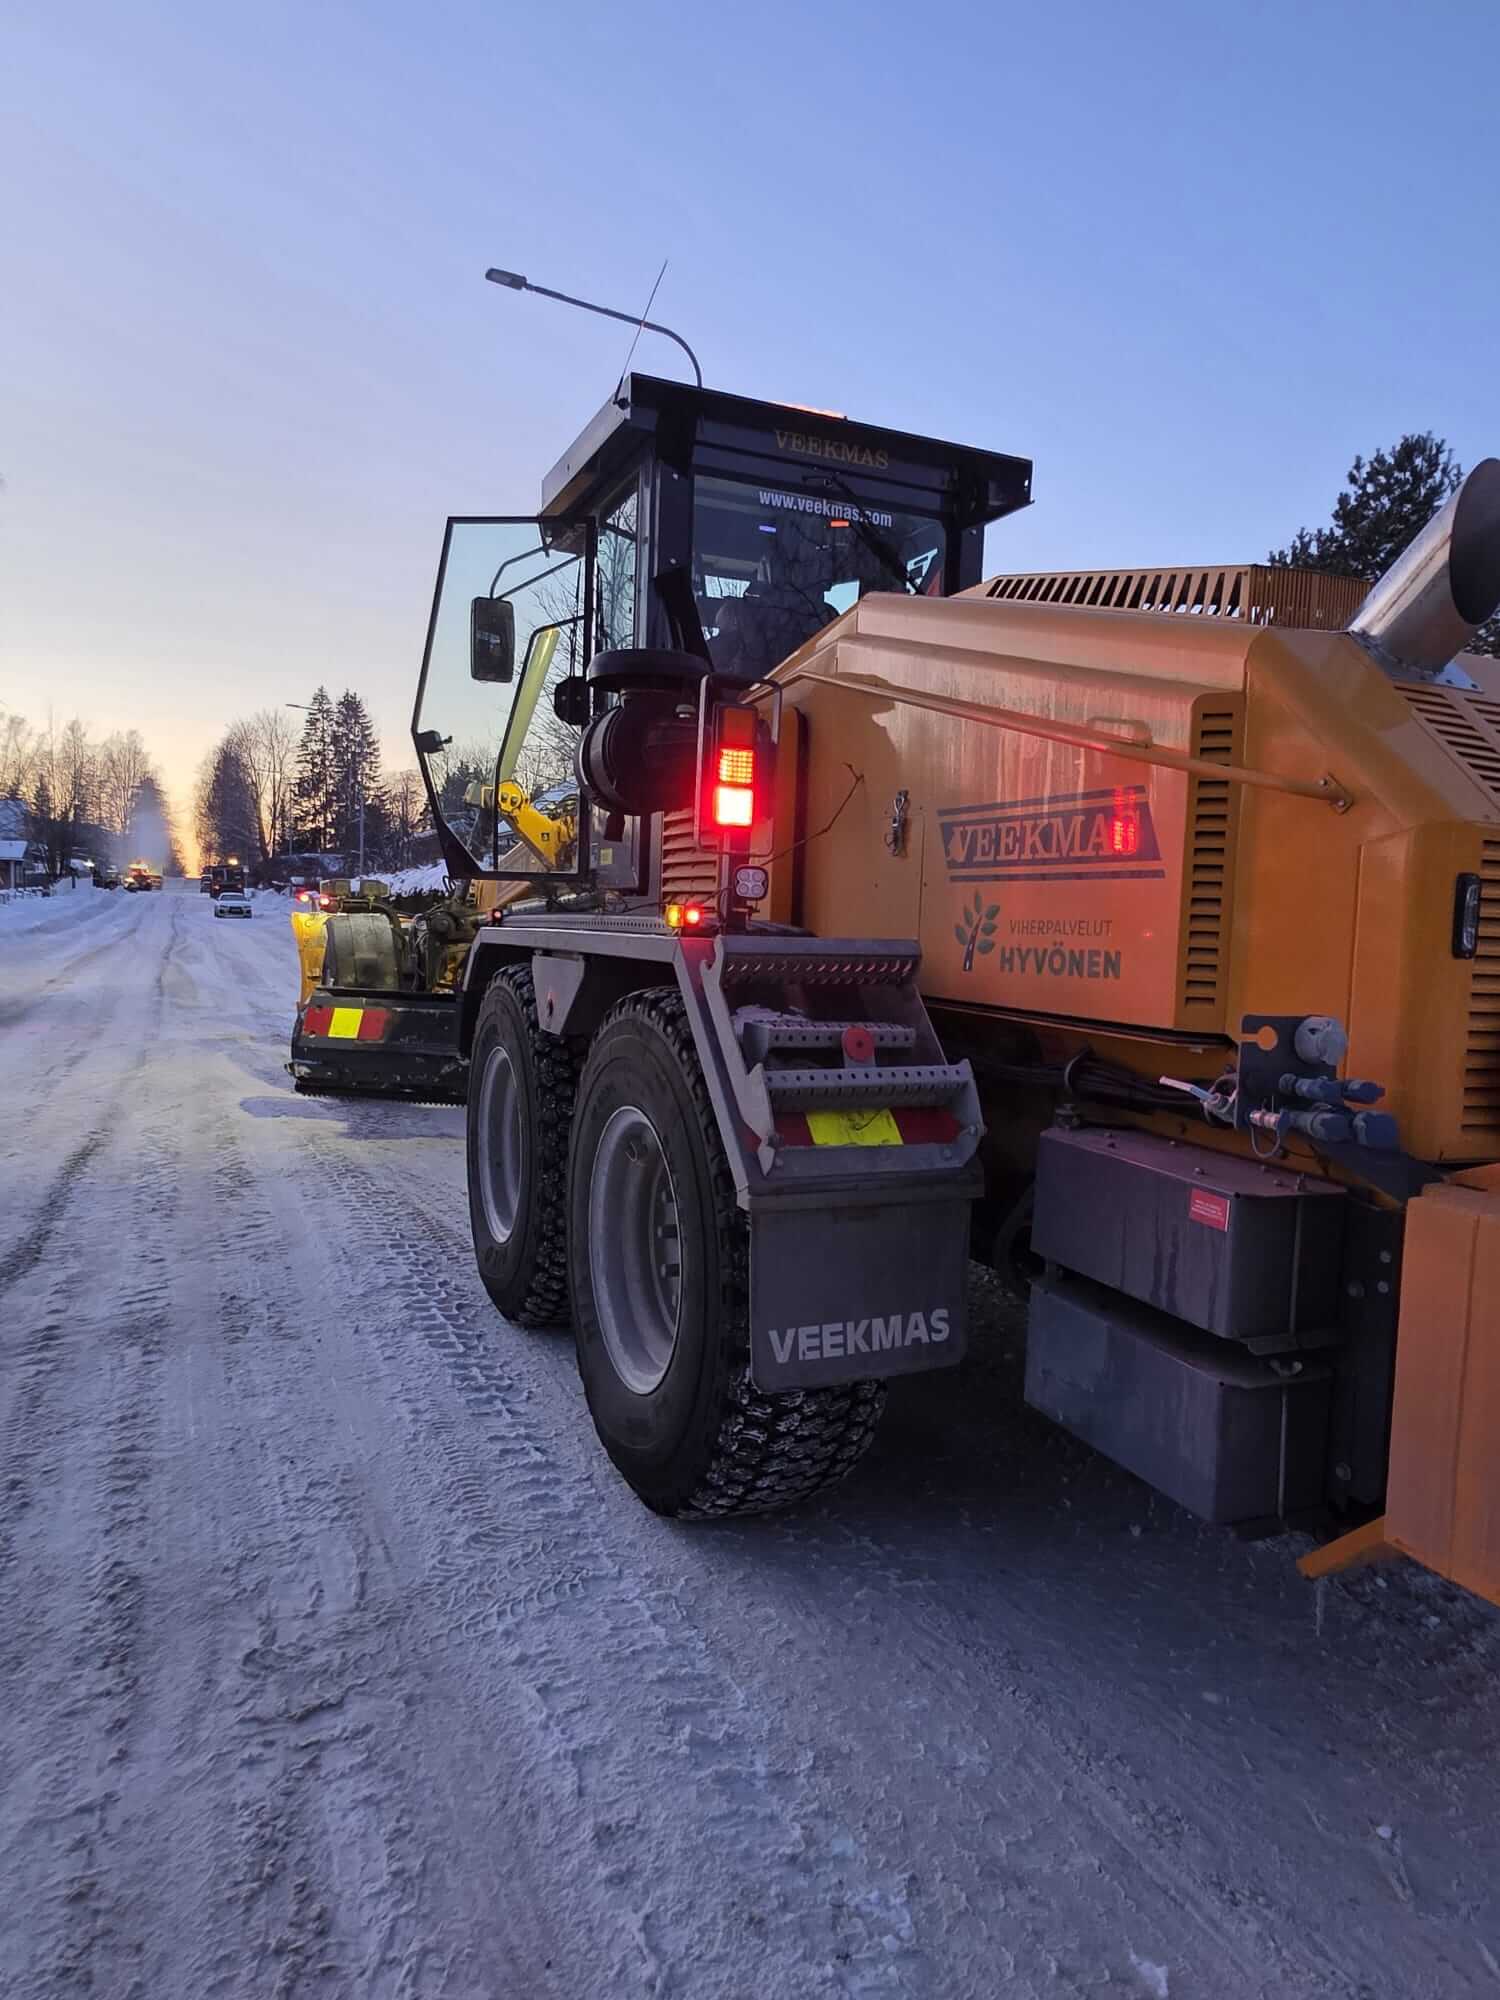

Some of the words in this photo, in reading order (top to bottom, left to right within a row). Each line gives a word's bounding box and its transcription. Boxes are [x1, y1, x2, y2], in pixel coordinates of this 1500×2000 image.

[775, 430, 889, 469] VEEKMAS
[759, 491, 892, 527] www.veekmas.com
[1010, 919, 1113, 936] VIHERPALVELUT
[999, 941, 1122, 979] HYVÖNEN
[767, 1308, 950, 1364] VEEKMAS
